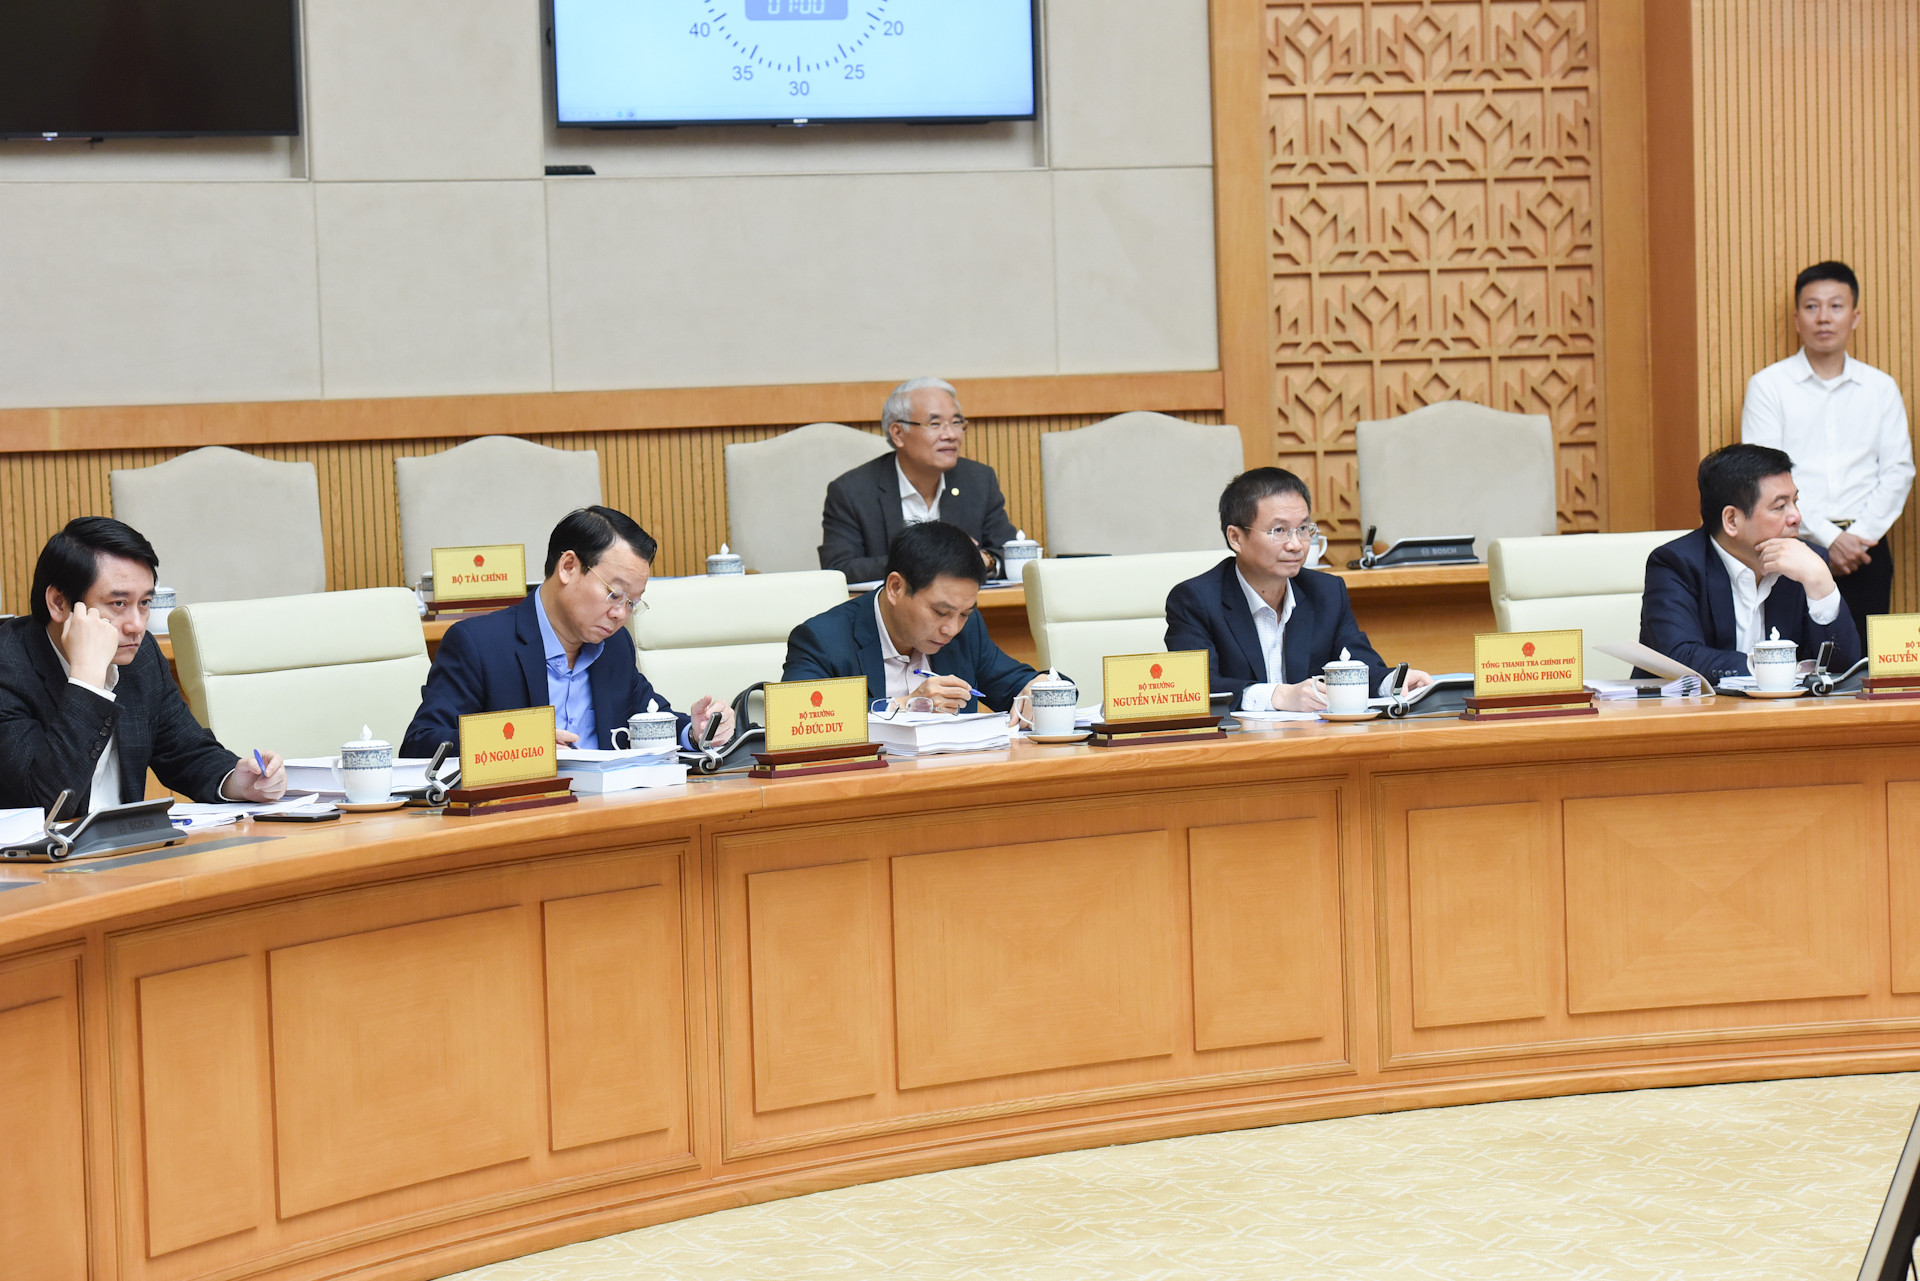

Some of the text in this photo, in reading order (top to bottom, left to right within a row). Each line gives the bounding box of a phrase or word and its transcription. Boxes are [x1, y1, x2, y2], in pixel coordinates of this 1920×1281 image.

[689, 22, 711, 37] 40
[883, 20, 904, 36] 20
[732, 65, 753, 81] 35
[844, 64, 865, 80] 25
[789, 80, 810, 96] 30
[452, 572, 508, 584] BỘ TÀI CHÍNH
[1481, 661, 1500, 669] TỔNG
[1502, 660, 1525, 668] THANH
[1540, 658, 1561, 666] CHÍNH
[1562, 656, 1576, 665] PHỦ
[1878, 650, 1918, 663] NGUYỄN
[1486, 669, 1572, 683] ĐOÀN HỒNG PHONG
[1138, 683, 1147, 691] BỘ
[1113, 689, 1201, 707] NGUYỄN VĂN THẮNG
[799, 712, 808, 720] BỘ
[806, 722, 824, 734] ĐỨC
[825, 722, 843, 732] DUY
[475, 746, 544, 765] BỘ NGOẠI GIAO
[129, 819, 155, 830] BOSCH
